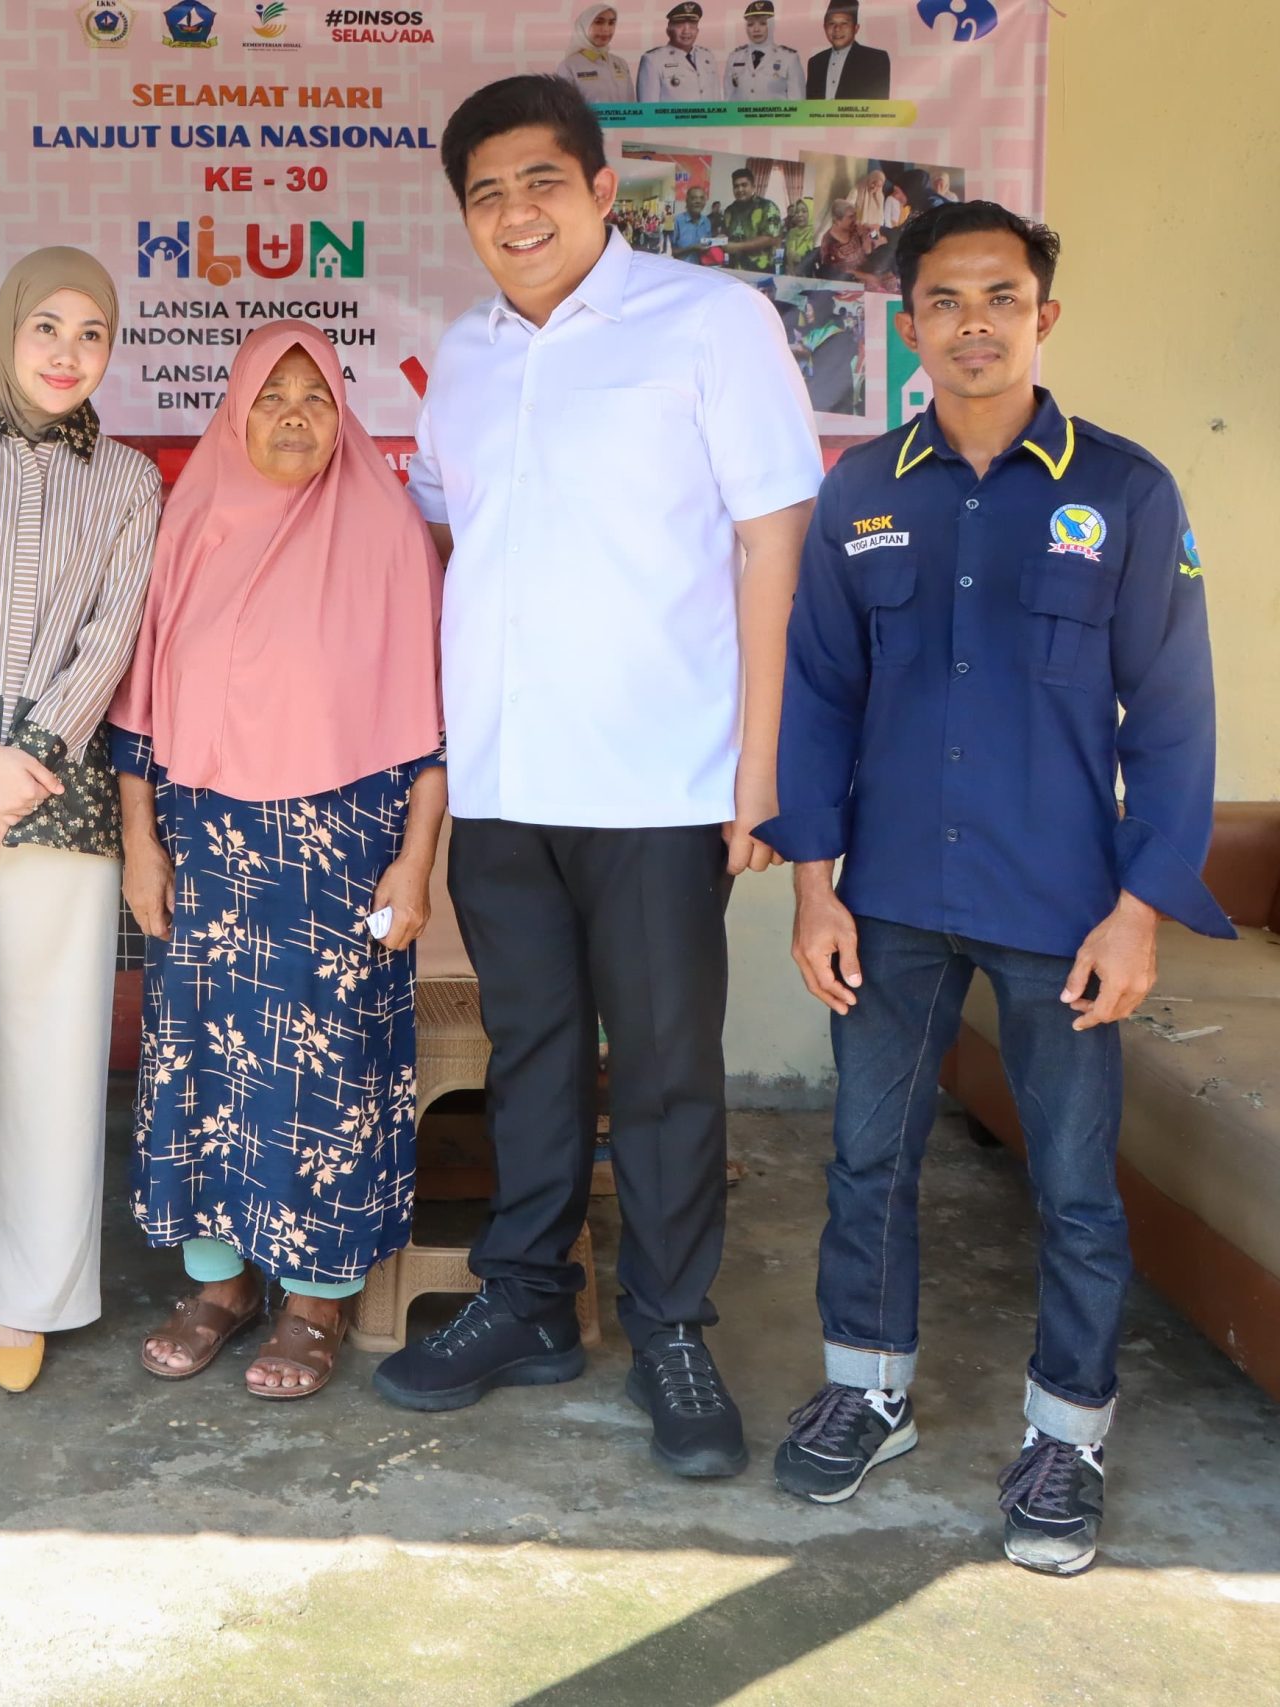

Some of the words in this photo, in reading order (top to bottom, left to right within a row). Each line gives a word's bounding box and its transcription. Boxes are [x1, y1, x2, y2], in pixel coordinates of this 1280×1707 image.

[325, 10, 423, 26] #DINSOS
[132, 84, 289, 108] SELAMAT
[299, 87, 383, 109] HARI
[32, 125, 161, 148] LANJUT
[171, 125, 251, 148] USIA
[261, 126, 436, 149] NASIONAL
[205, 166, 252, 191] KE
[286, 167, 328, 192] 30
[139, 301, 229, 318] LANSIA
[236, 301, 358, 318] TANGGUH
[142, 365, 229, 382] LANSIA
[853, 515, 893, 535] TKSK
[851, 540, 868, 552] YOGI
[870, 534, 904, 547] ALPIAN
